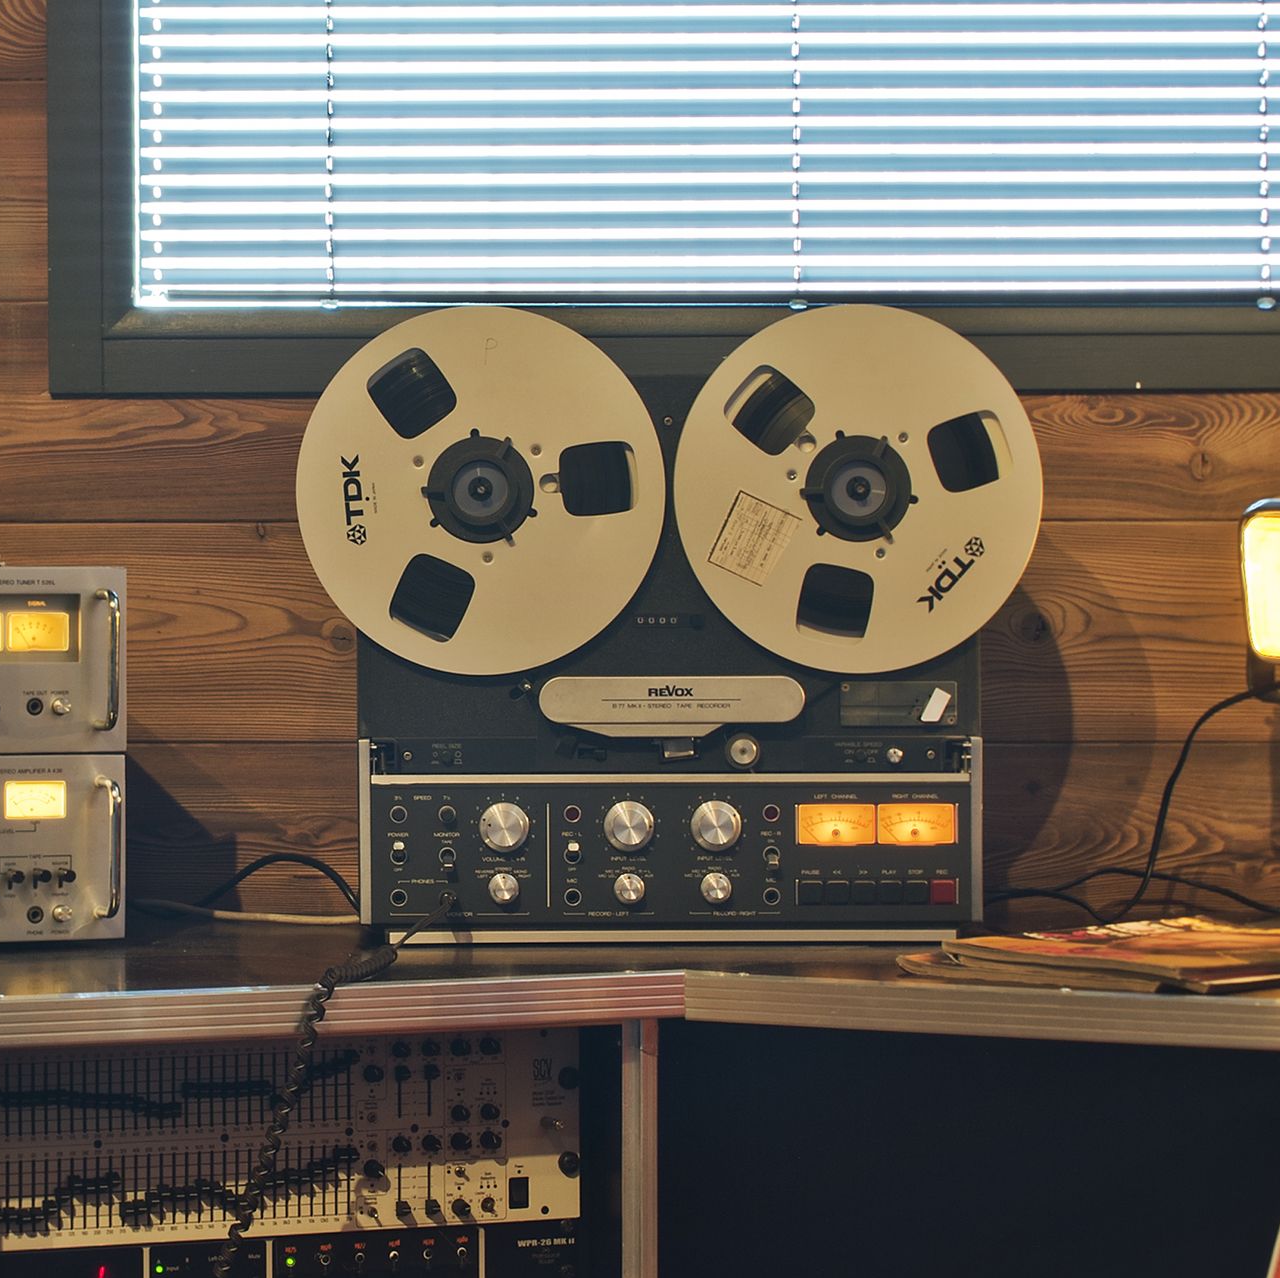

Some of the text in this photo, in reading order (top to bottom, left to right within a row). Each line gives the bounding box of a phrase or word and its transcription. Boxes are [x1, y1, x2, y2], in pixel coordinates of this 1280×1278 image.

[340, 454, 364, 526] TDK
[916, 556, 976, 614] TDK
[648, 685, 694, 697] REVOX
[533, 1058, 552, 1078] SCV
